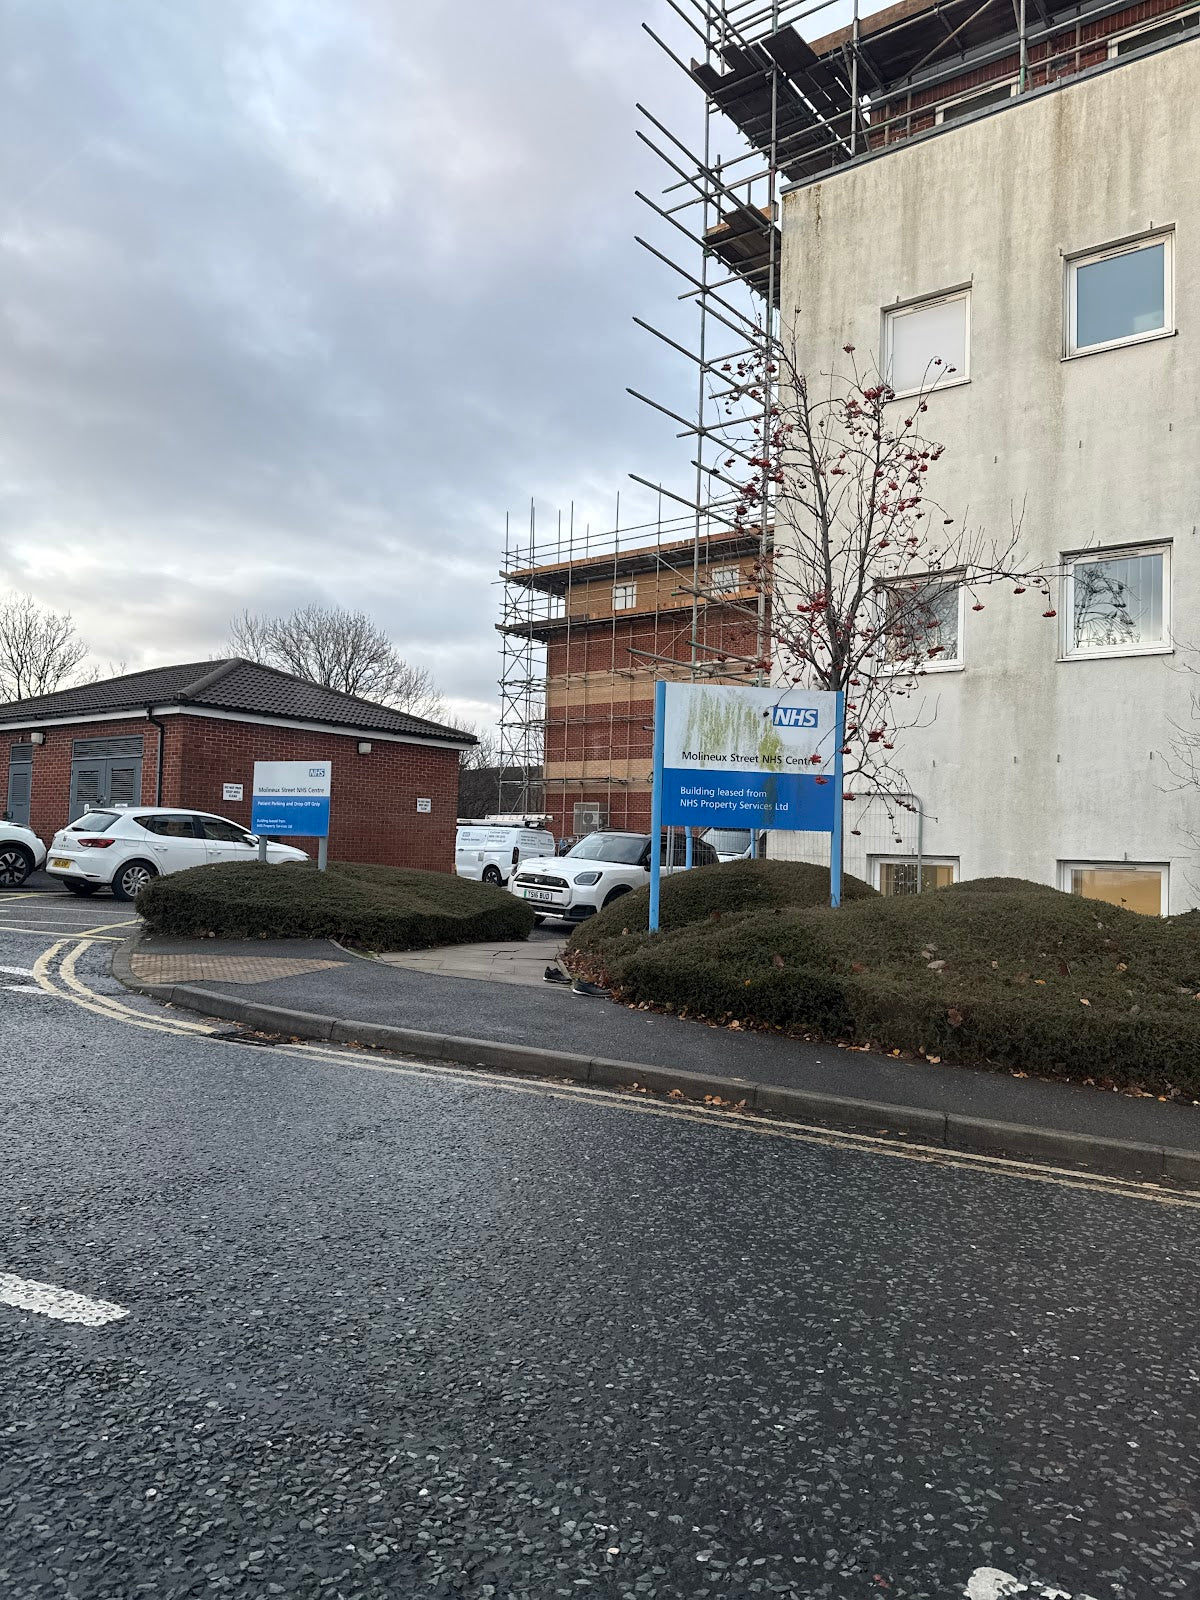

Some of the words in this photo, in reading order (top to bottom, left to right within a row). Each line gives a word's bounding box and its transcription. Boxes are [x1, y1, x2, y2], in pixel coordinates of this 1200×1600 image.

[774, 708, 818, 727] NHS
[682, 751, 727, 762] Molineux
[730, 754, 759, 764] Street
[762, 756, 783, 765] NHS
[309, 769, 325, 777] NHS
[680, 787, 715, 798] Building
[717, 788, 744, 798] leased
[746, 789, 767, 799] from
[680, 800, 698, 808] NHS
[700, 801, 737, 811] Property
[739, 802, 773, 811] Services
[775, 803, 789, 811] Ltd
